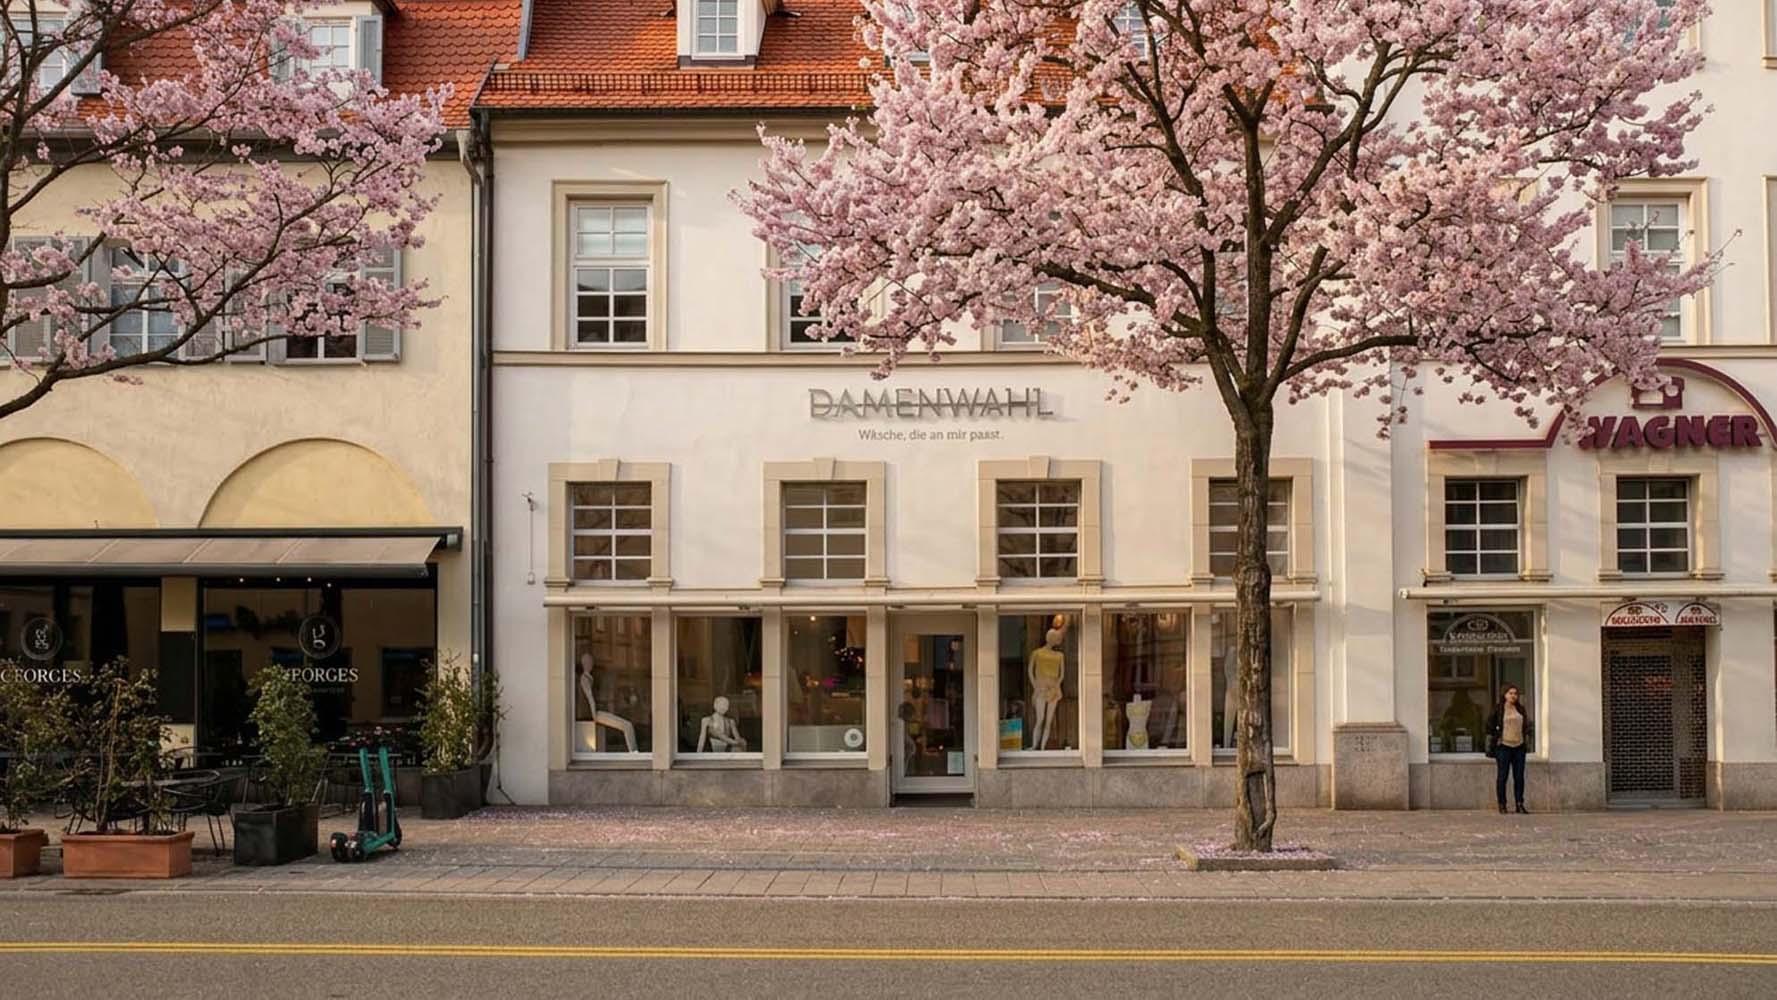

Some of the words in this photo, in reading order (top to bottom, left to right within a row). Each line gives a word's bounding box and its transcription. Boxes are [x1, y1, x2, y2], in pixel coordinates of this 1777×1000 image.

[808, 388, 1054, 418] DAMENWAHL
[908, 429, 927, 441] die
[929, 431, 944, 441] an
[946, 429, 967, 441] mir
